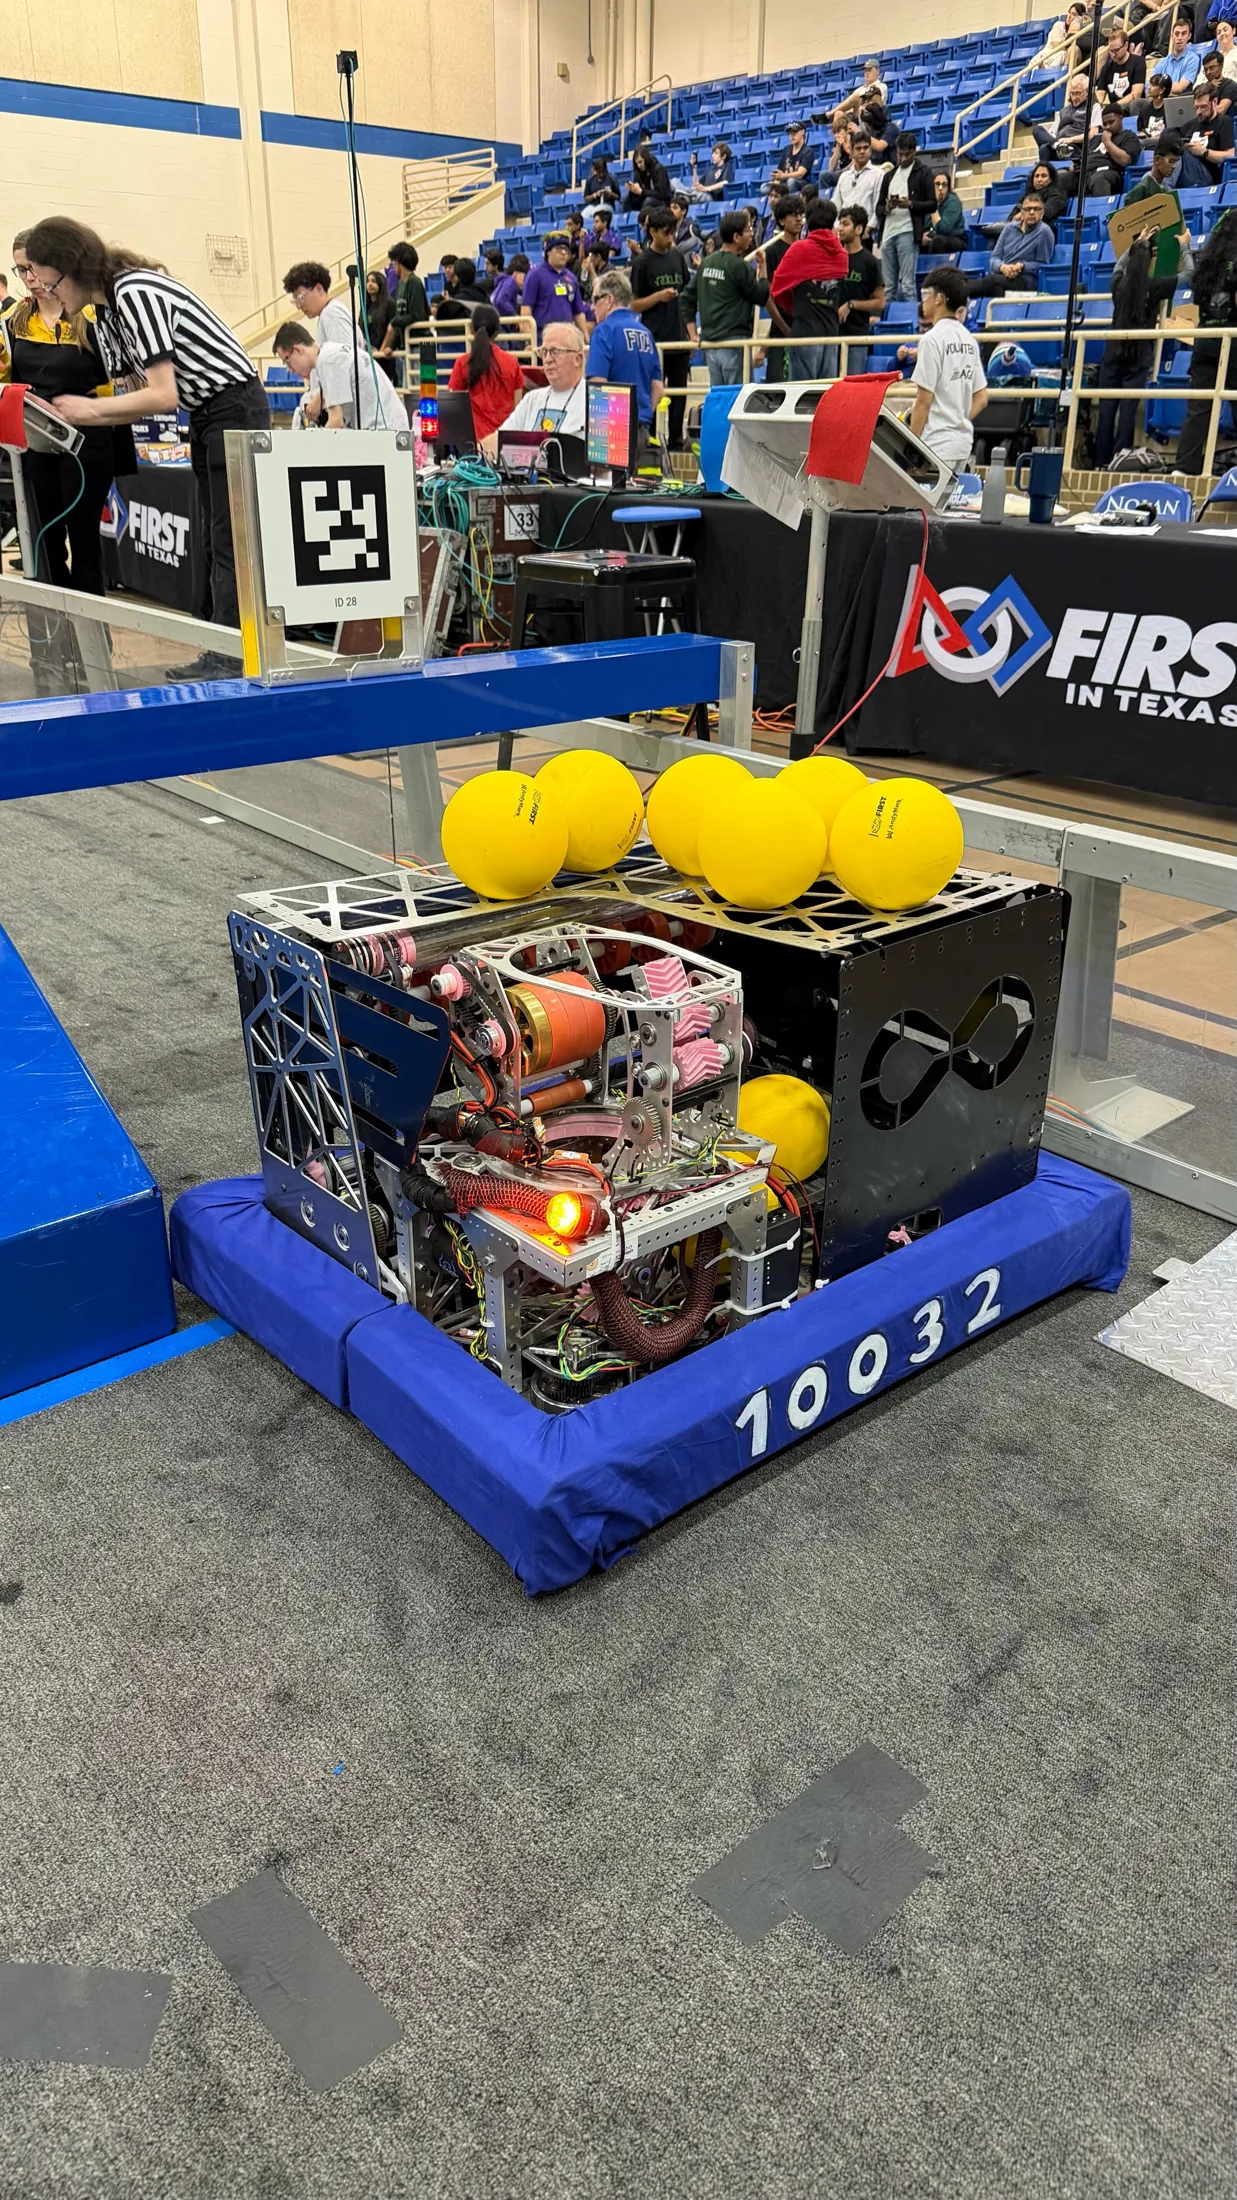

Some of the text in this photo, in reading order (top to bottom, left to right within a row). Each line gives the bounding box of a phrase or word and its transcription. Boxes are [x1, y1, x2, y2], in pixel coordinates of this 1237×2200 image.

[623, 328, 654, 355] FTA
[1102, 495, 1180, 517] NOAN
[129, 500, 190, 557] FIRST
[517, 513, 534, 527] 33
[134, 540, 180, 568] IN TEXAS
[334, 596, 357, 608] ID 28
[1065, 683, 1237, 727] IN TEXAS
[875, 796, 887, 817] FIRST
[734, 1266, 1002, 1458] 10032
